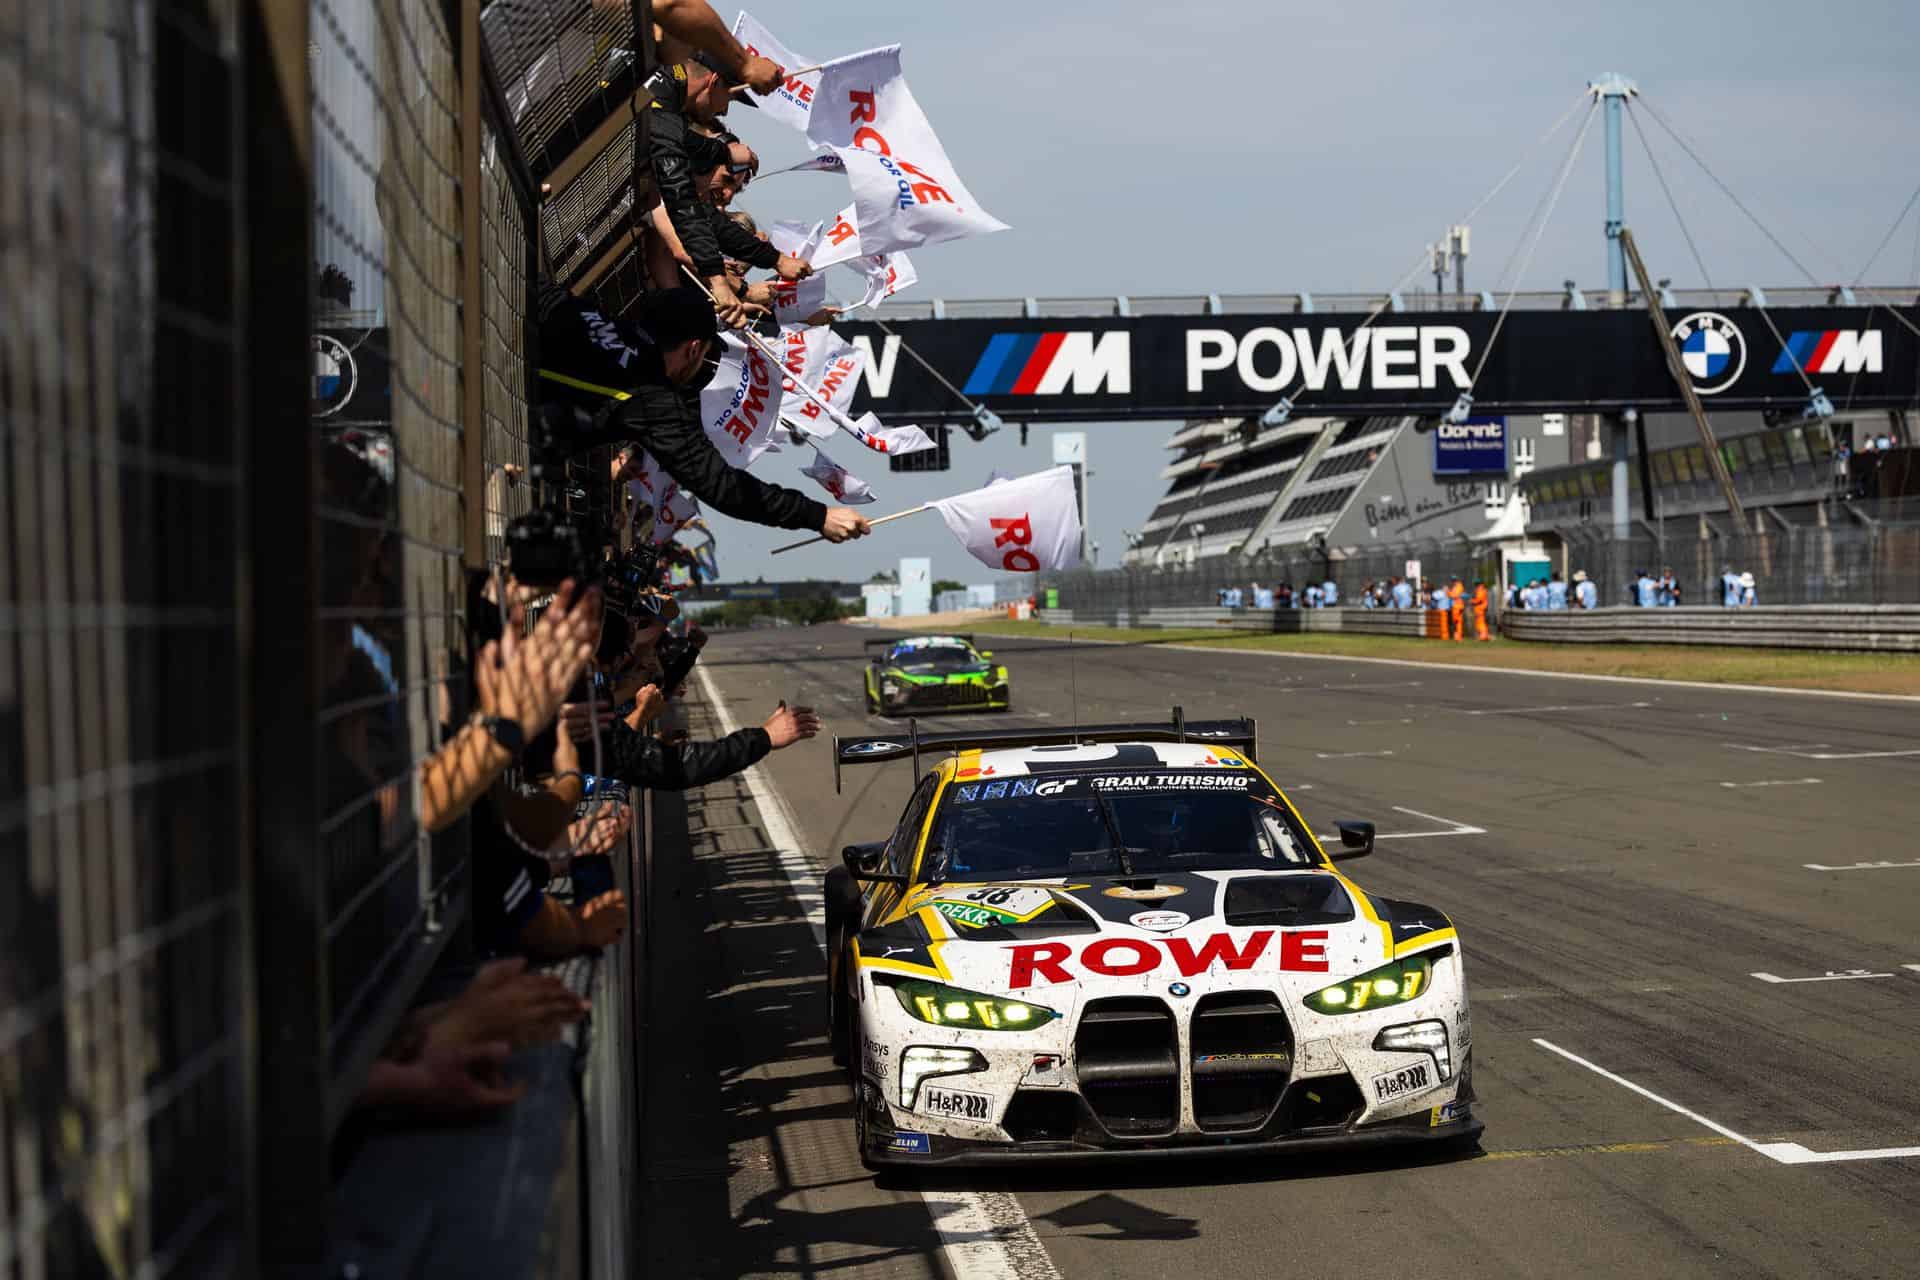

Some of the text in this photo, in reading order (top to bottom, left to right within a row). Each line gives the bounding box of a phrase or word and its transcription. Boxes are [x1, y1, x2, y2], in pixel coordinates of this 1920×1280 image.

[777, 87, 795, 103] TOR
[1678, 316, 1735, 341] BMW
[1186, 326, 1472, 393] POWER
[713, 408, 732, 428] OIL
[1090, 775, 1248, 788] GRAN TURISMO
[1000, 929, 1330, 990] ROWE
